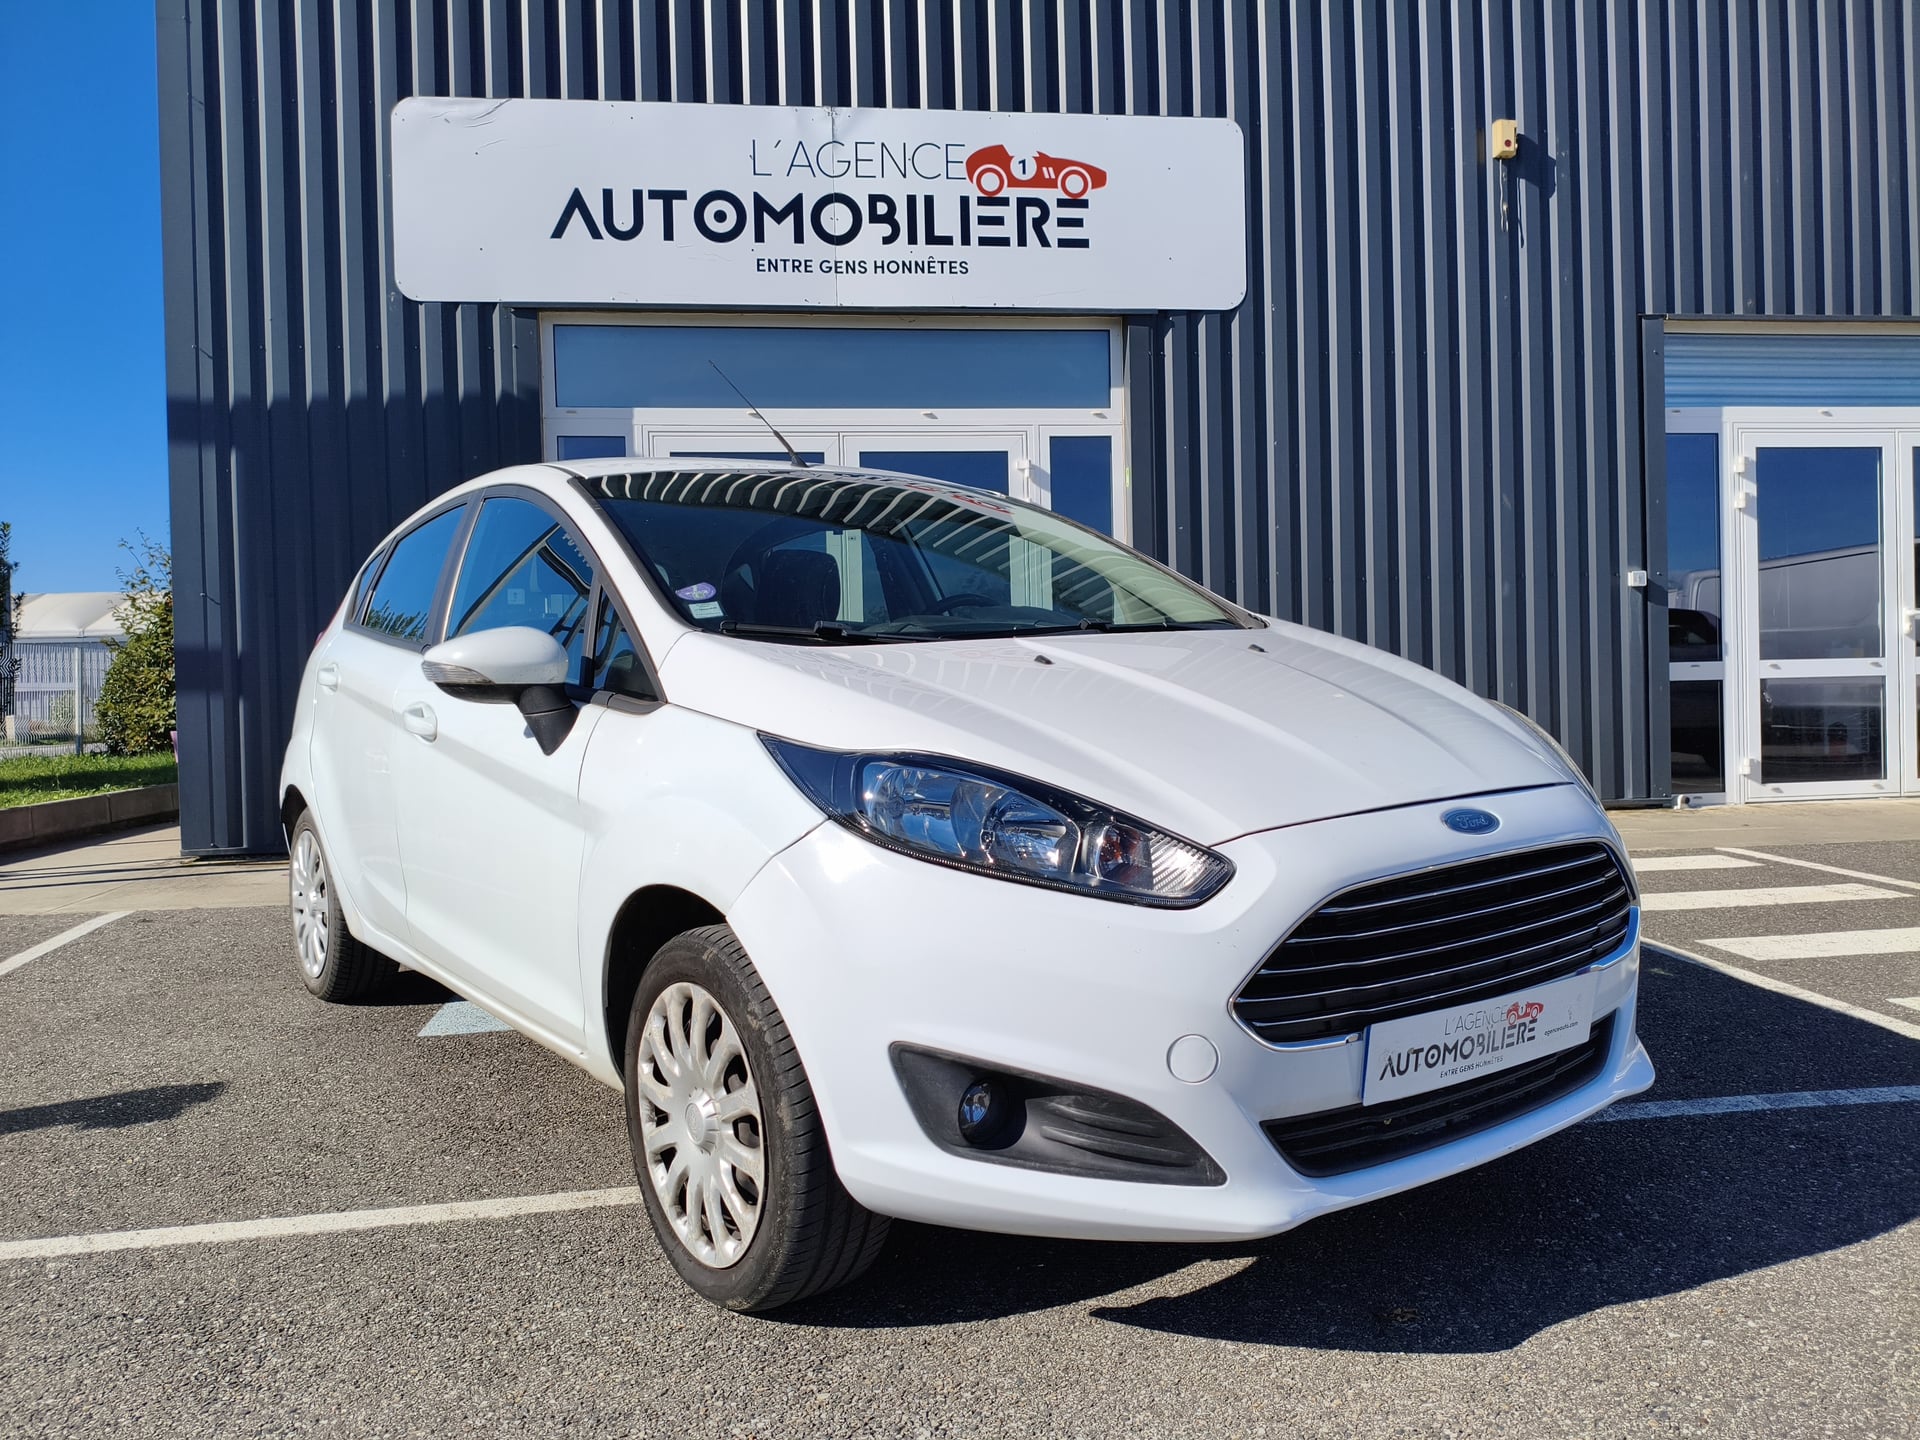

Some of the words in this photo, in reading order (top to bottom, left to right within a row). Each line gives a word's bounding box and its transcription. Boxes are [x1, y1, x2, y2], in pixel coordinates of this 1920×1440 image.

[1017, 158, 1027, 176] 1
[549, 187, 1090, 249] AUTOMOBILIERE
[756, 258, 814, 273] ENTRE
[819, 259, 868, 274] GENS
[873, 255, 969, 275] HONNÊTES
[1456, 814, 1489, 829] Ford
[1379, 1018, 1538, 1081] AUTOMOBILIERE
[1440, 1067, 1459, 1079] ENTRE
[1459, 1062, 1475, 1074] GENS
